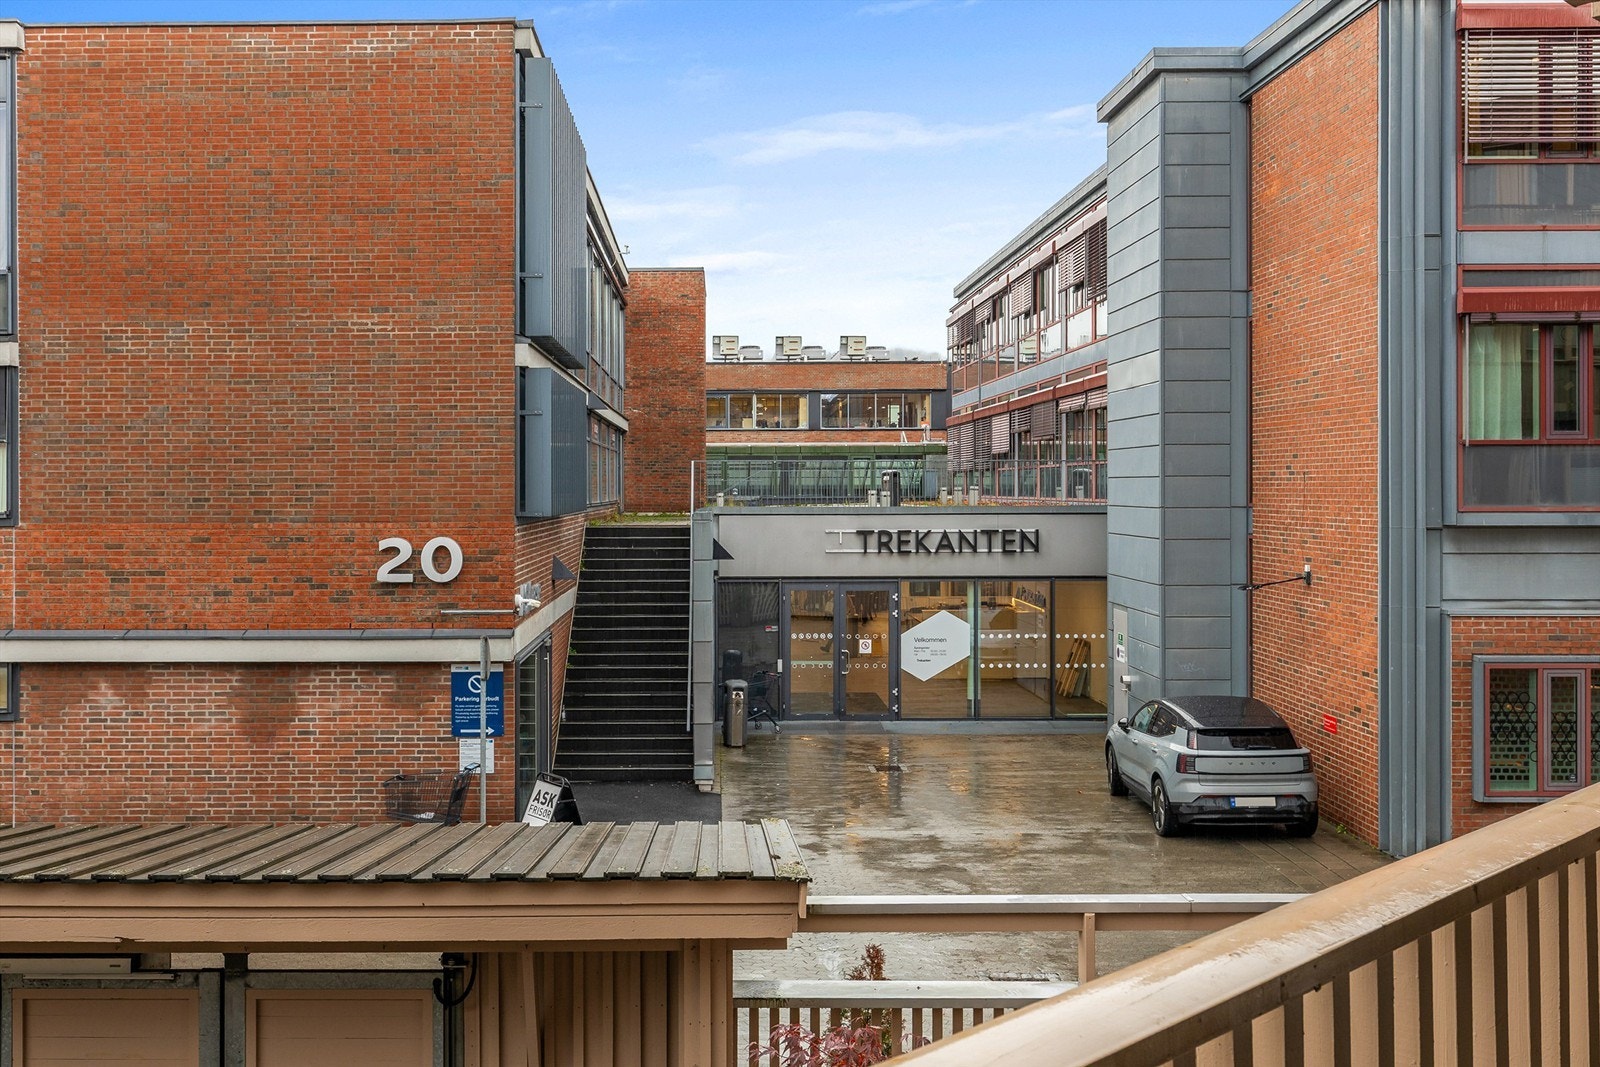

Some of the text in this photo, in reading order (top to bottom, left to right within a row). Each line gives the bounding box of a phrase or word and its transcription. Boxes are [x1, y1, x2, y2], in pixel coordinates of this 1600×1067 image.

[856, 529, 1040, 554] TREKANTEN
[376, 536, 464, 583] 20
[532, 789, 557, 809] ASK
